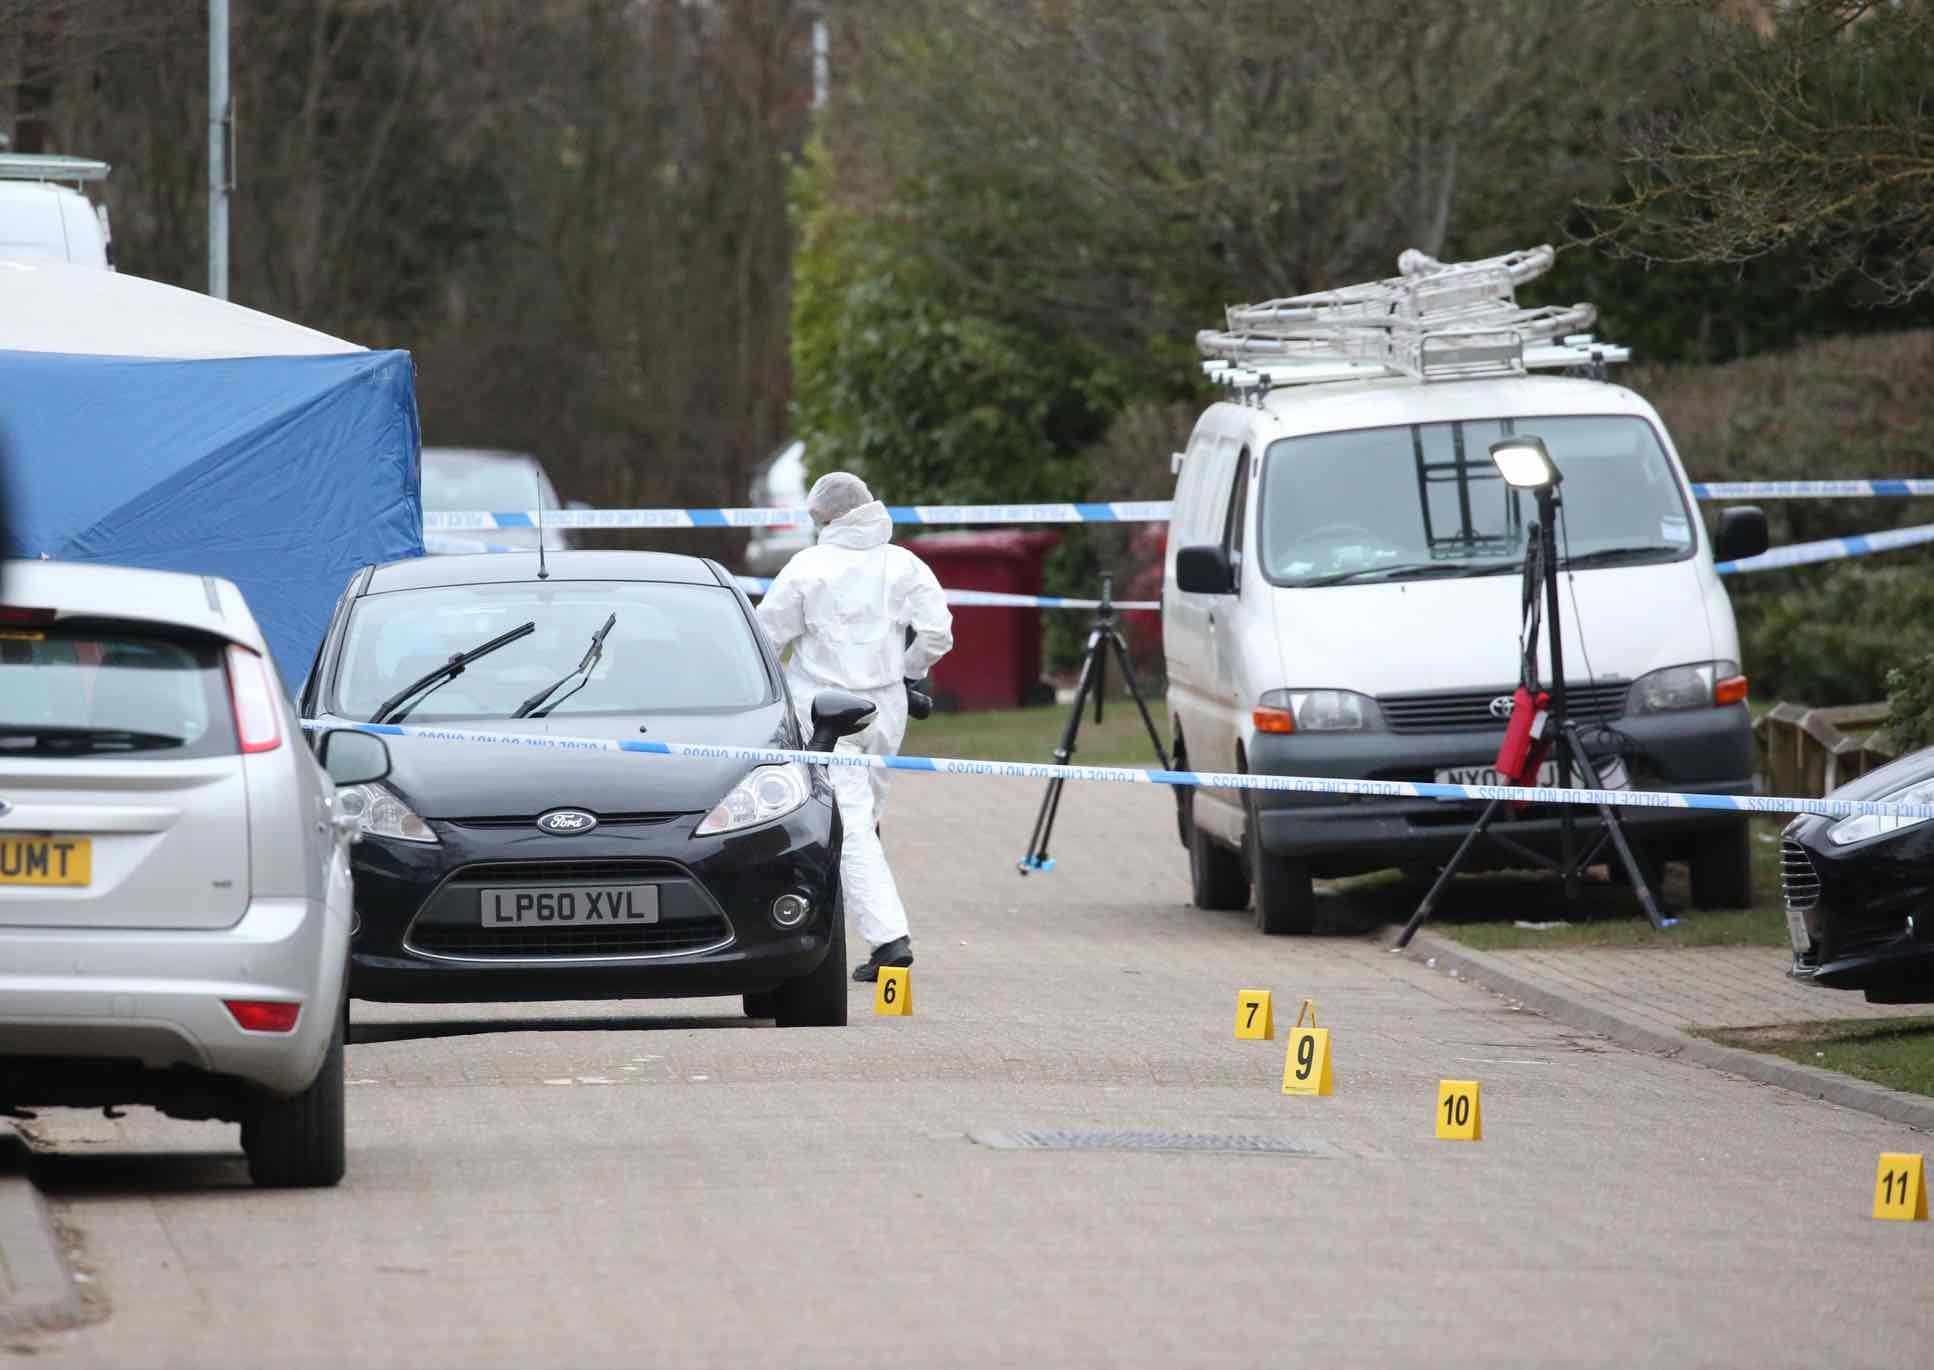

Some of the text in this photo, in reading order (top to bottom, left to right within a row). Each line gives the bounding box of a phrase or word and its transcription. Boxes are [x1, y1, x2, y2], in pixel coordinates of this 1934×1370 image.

[1479, 787, 1671, 807] POLICE LINE DO NOT CROSS
[1748, 797, 1794, 811] CROSS
[1801, 799, 1828, 813] NOT
[1857, 801, 1888, 817] LINE
[1893, 802, 1934, 818] OLICE
[549, 813, 584, 829] Ford
[0, 842, 76, 878] UMT
[494, 890, 646, 923] LP60 XVL
[882, 977, 898, 1005] 6
[1244, 1002, 1260, 1029] 7
[1294, 1034, 1316, 1081] 9
[1443, 1094, 1470, 1127] 10
[1881, 1169, 1910, 1205] 11
